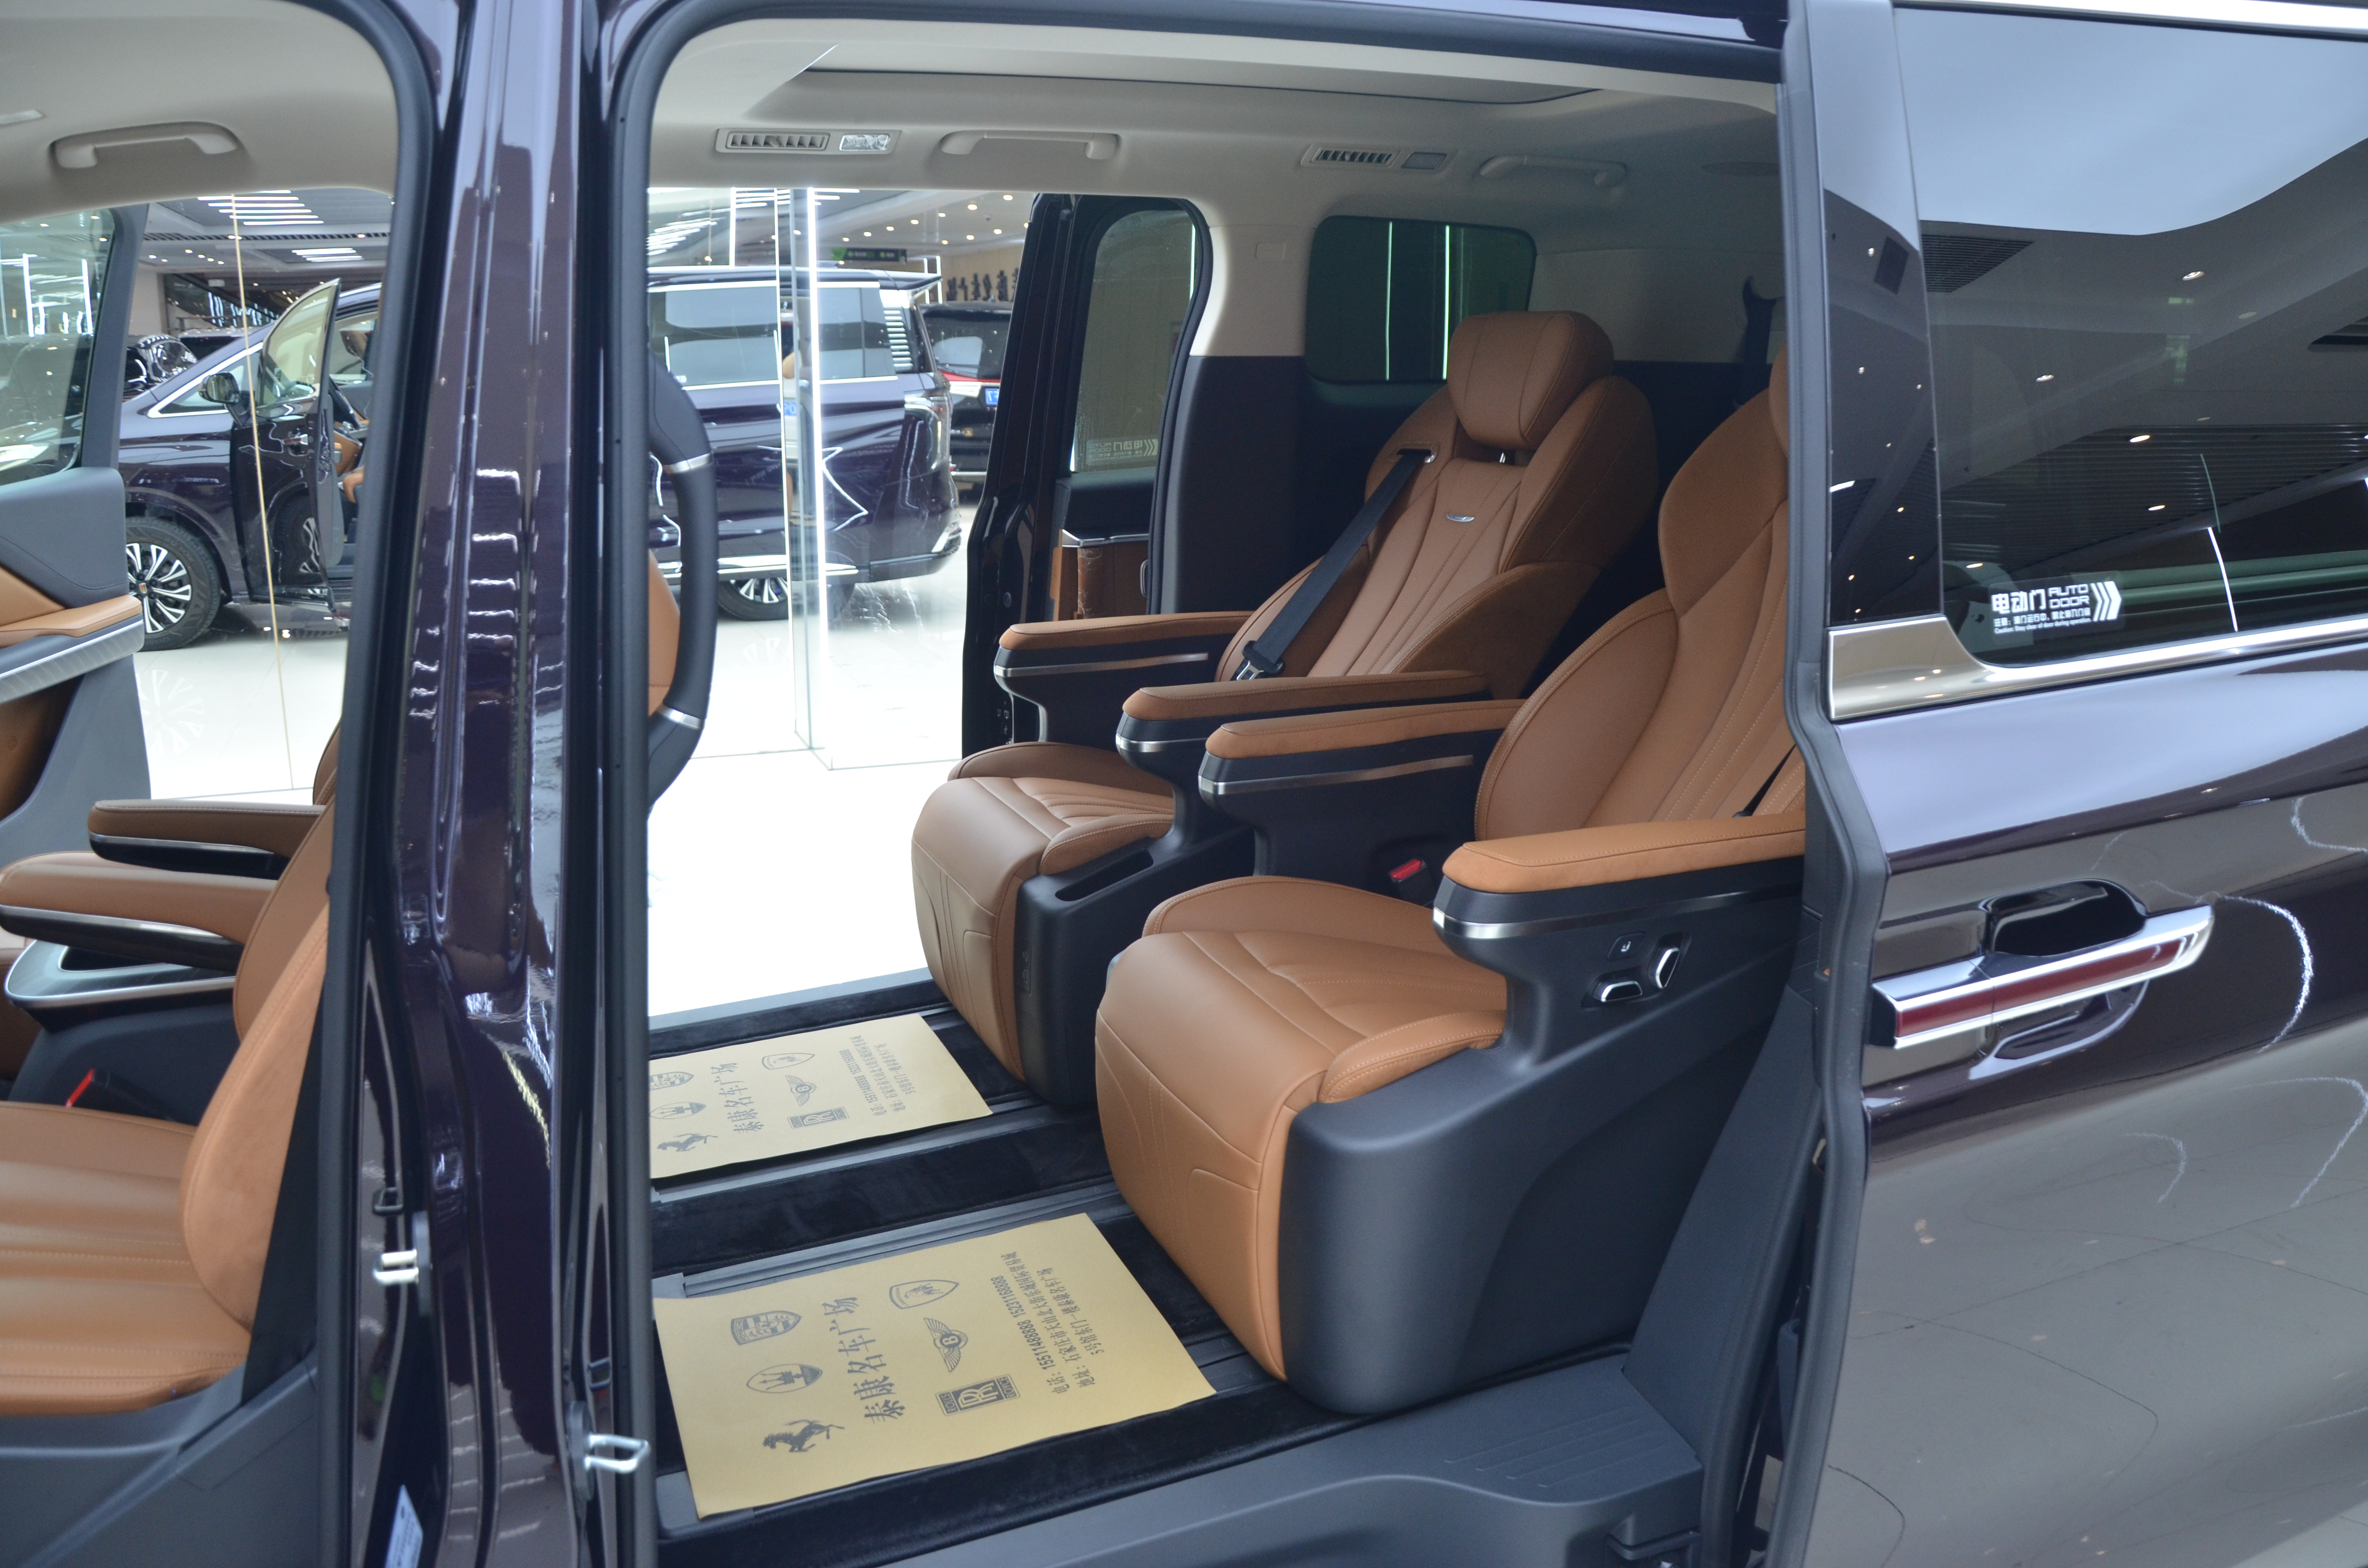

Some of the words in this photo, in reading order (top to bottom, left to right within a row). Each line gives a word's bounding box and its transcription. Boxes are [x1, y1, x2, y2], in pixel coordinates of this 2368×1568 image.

[1991, 588, 2047, 615] 电动门
[2048, 584, 2088, 597] AUTO
[2049, 595, 2089, 608] DOOR
[711, 1063, 764, 1134] 泰康名车广场
[991, 1276, 1025, 1317] 15231168888
[822, 1297, 905, 1422] 泰康名车广场
[997, 1376, 1016, 1397] ROYCE
[941, 1393, 957, 1412] ROLLS
